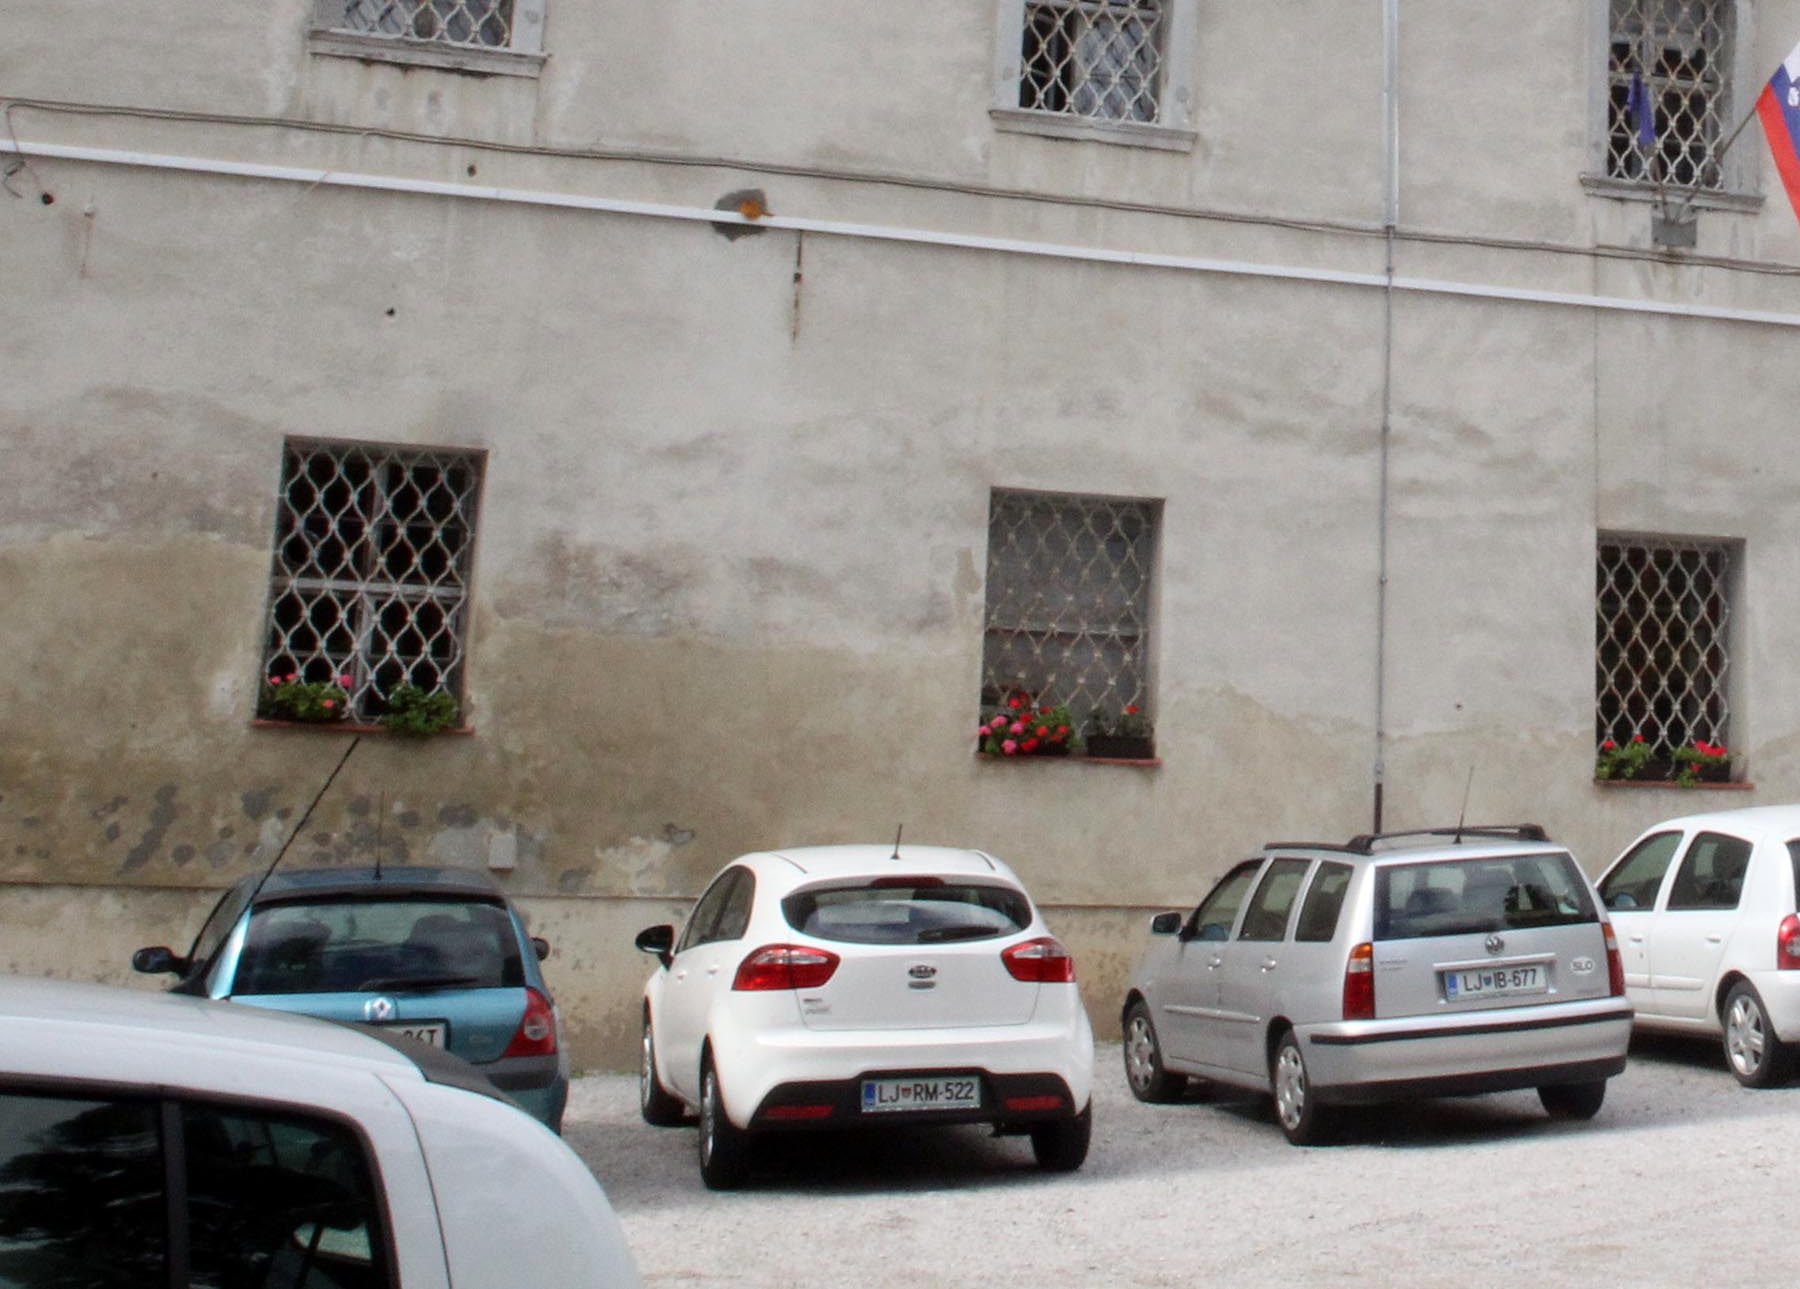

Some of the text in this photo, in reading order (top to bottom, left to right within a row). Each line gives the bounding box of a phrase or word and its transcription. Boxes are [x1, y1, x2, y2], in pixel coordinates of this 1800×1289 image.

[1572, 960, 1593, 972] SLO
[1464, 968, 1537, 992] LJ IB-677
[878, 1081, 975, 1103] LJ RM-522
